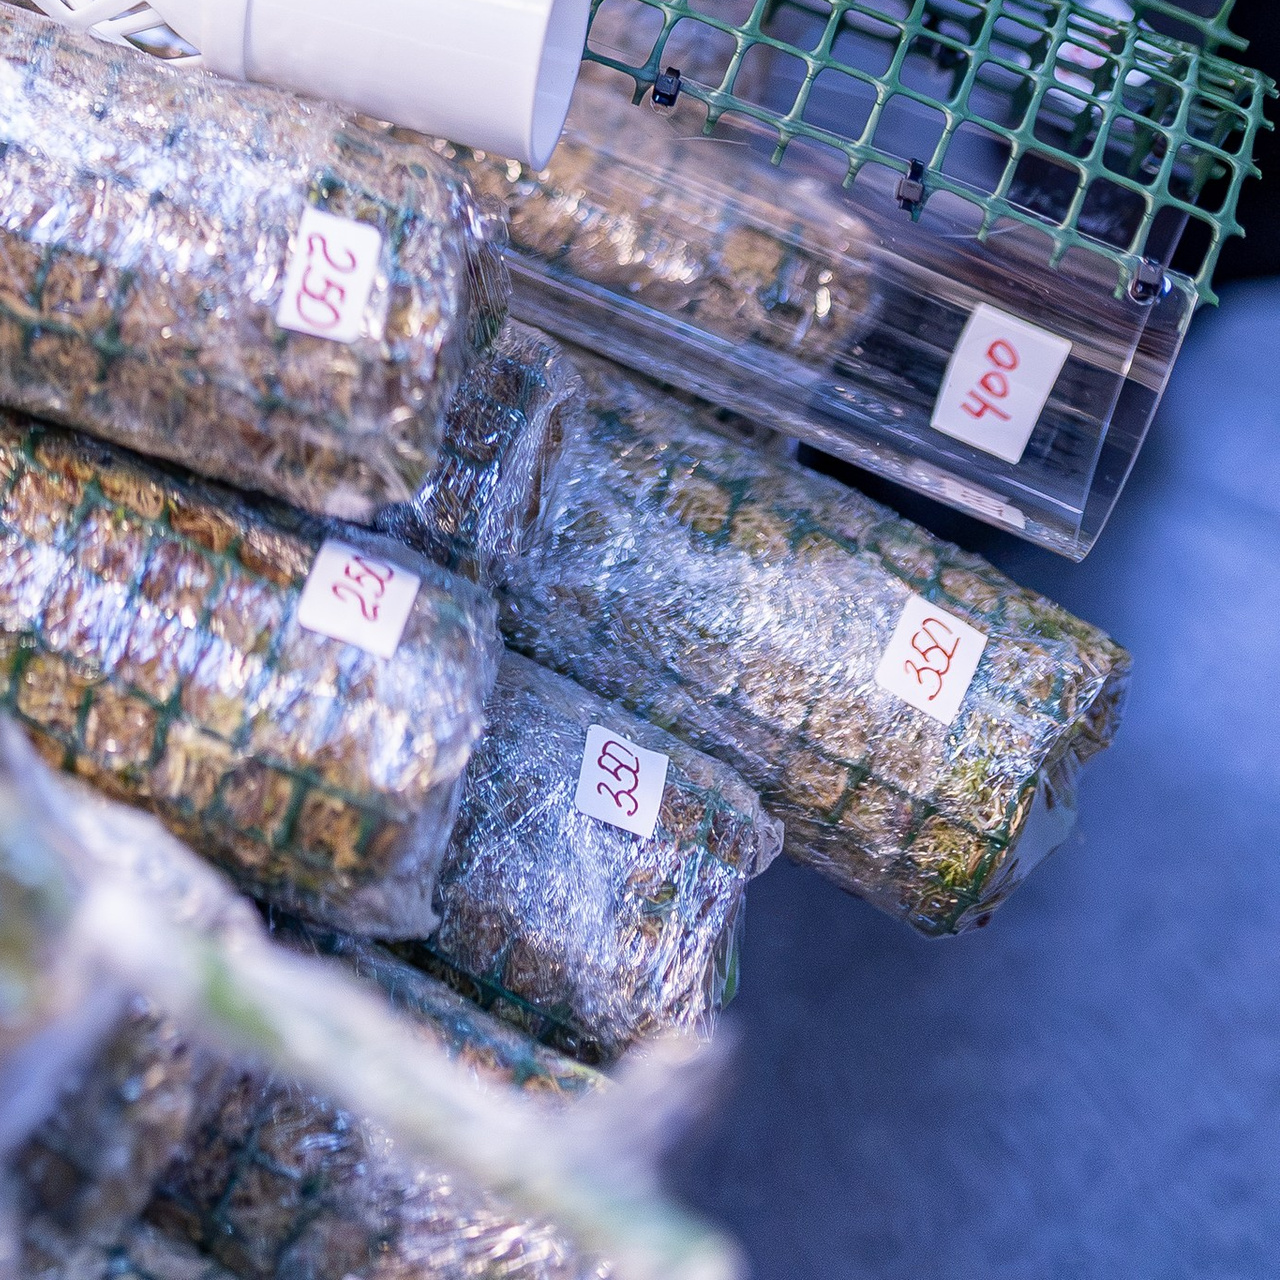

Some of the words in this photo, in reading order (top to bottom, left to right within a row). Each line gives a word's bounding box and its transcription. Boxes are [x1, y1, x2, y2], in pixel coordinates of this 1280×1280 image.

[296, 232, 357, 330] 250
[960, 339, 1018, 422] 400
[903, 617, 961, 701] 350
[597, 740, 640, 817] 350
